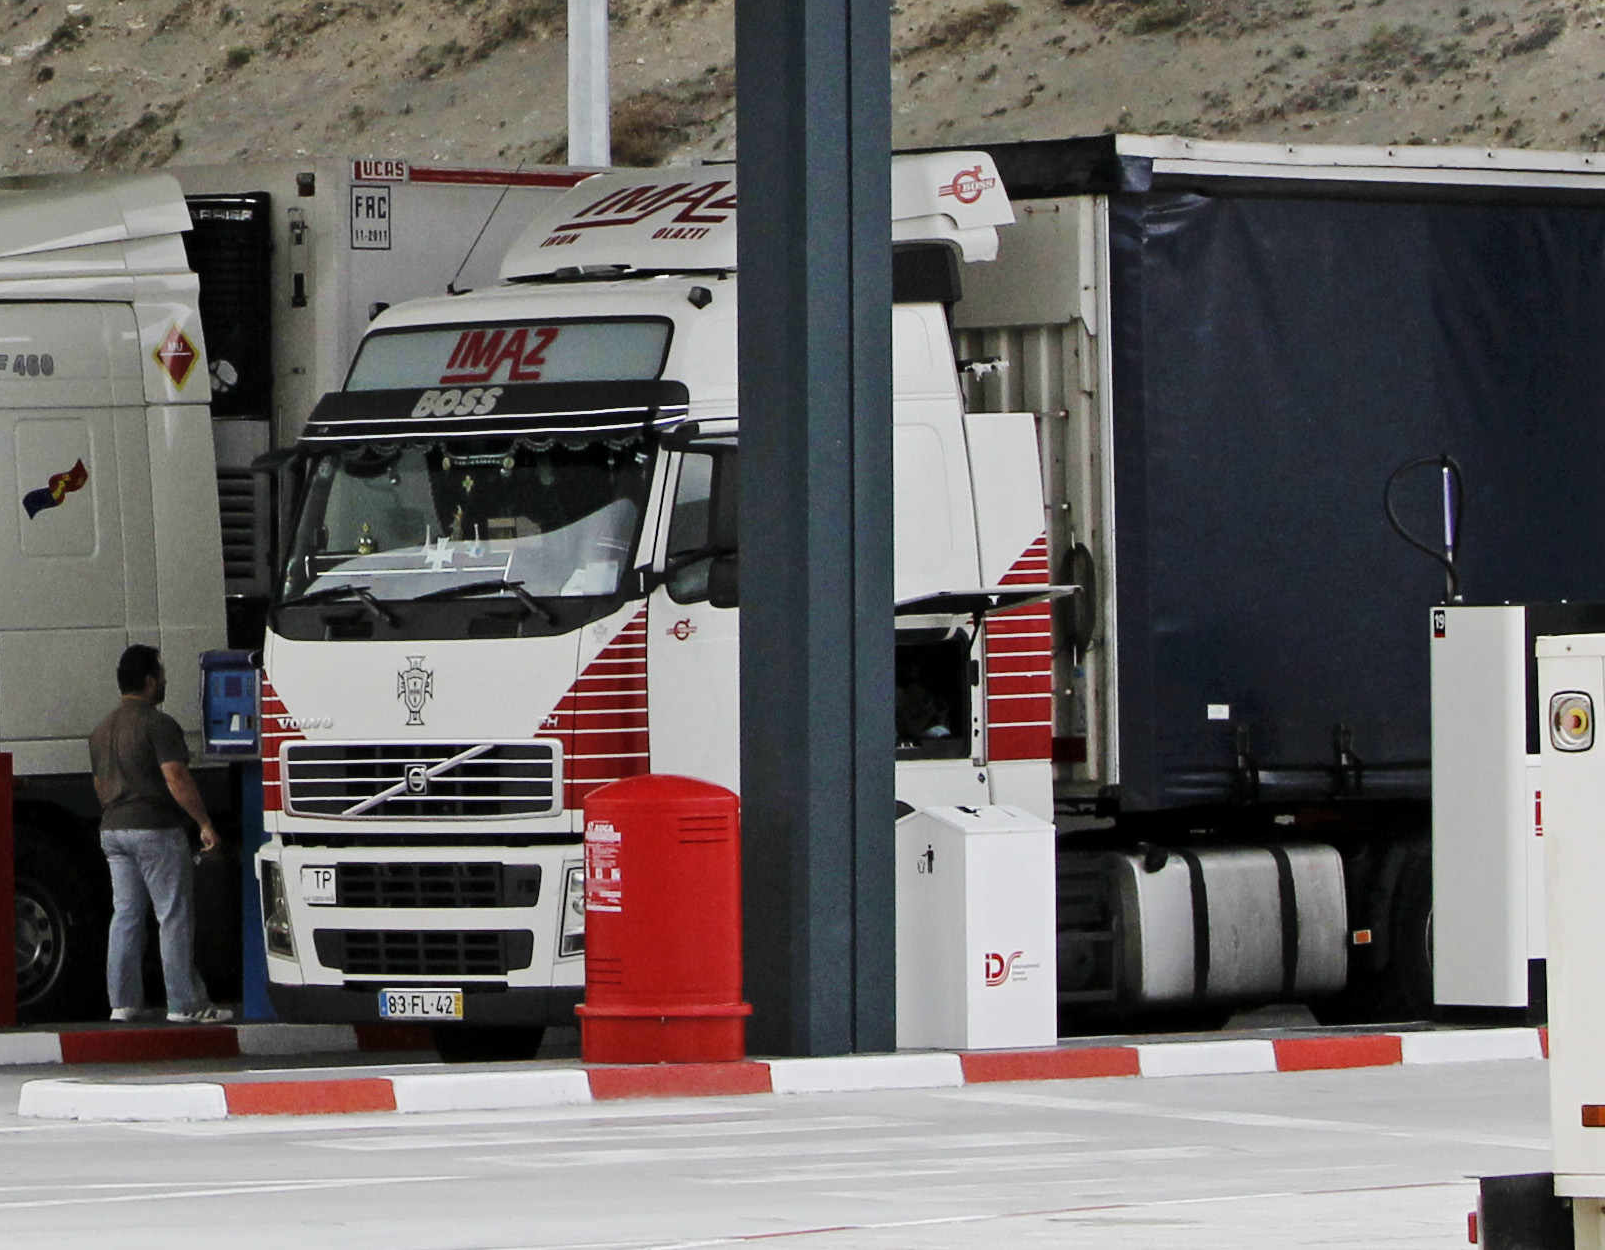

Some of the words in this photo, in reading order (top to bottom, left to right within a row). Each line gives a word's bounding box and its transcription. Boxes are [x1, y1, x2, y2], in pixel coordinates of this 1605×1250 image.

[439, 327, 560, 385] IMAZ
[411, 387, 504, 418] BOSS
[277, 717, 334, 730] VOLVO
[539, 716, 559, 728] FH
[314, 870, 332, 889] TP
